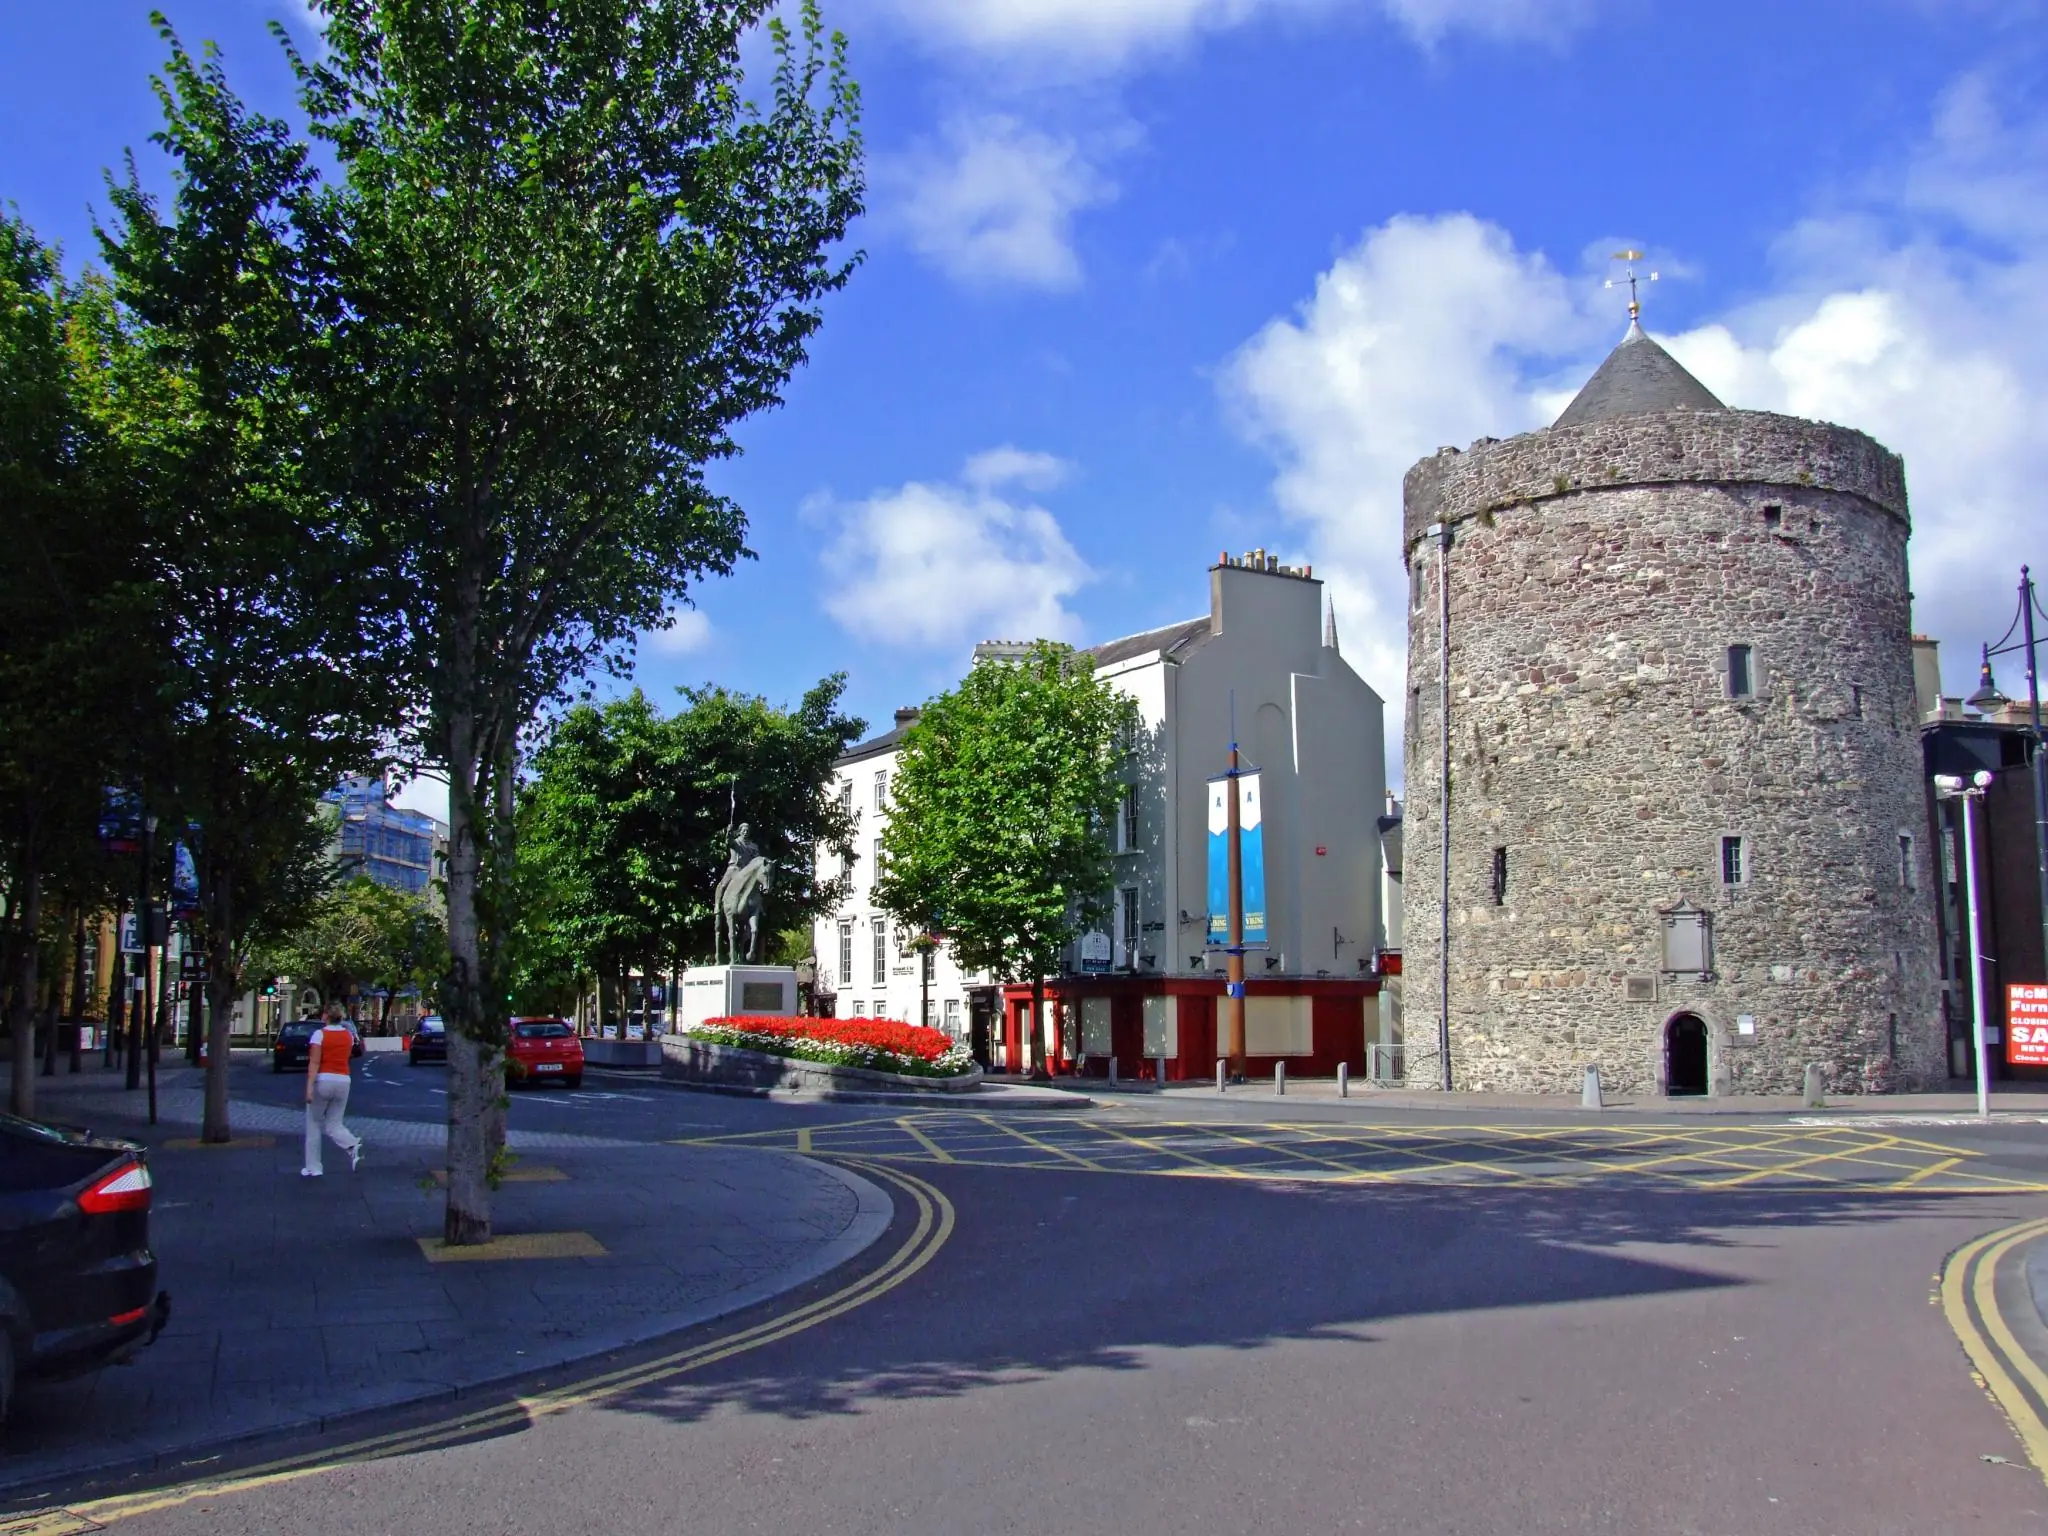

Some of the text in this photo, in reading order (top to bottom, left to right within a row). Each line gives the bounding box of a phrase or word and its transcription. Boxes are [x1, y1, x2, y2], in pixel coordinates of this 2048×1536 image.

[1245, 917, 1264, 925] VIKING
[2011, 987, 2048, 999] McM
[2011, 1000, 2048, 1012] Furn
[2011, 1017, 2048, 1025] CLOSIN
[2012, 1027, 2048, 1043] SA
[2021, 1045, 2046, 1053] NEW
